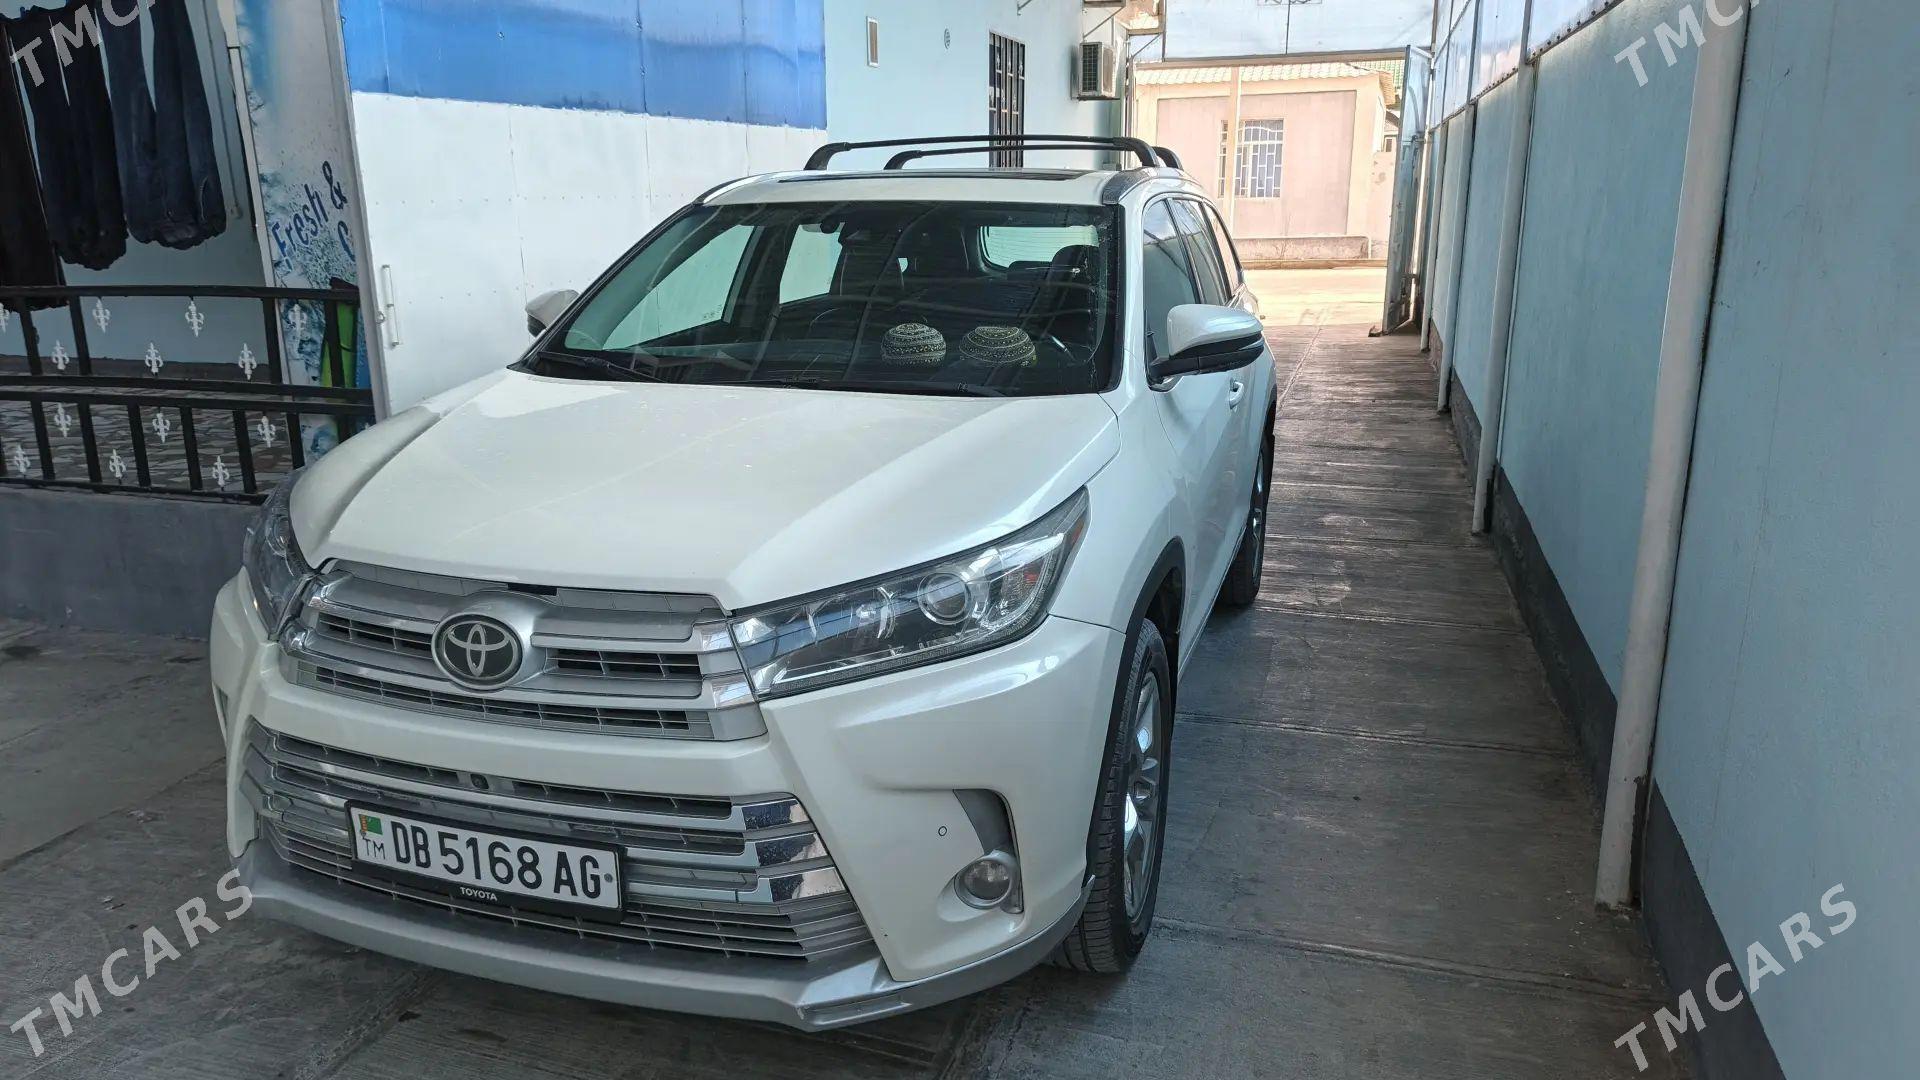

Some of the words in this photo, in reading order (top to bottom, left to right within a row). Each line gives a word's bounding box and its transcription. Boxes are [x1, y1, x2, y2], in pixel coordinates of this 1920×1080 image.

[271, 183, 329, 270] Fresh
[322, 160, 348, 210] &
[362, 838, 386, 860] TM
[390, 820, 431, 869] DB
[437, 830, 543, 890] 5168
[553, 850, 602, 899] AG
[460, 886, 499, 902] TOYOTA
